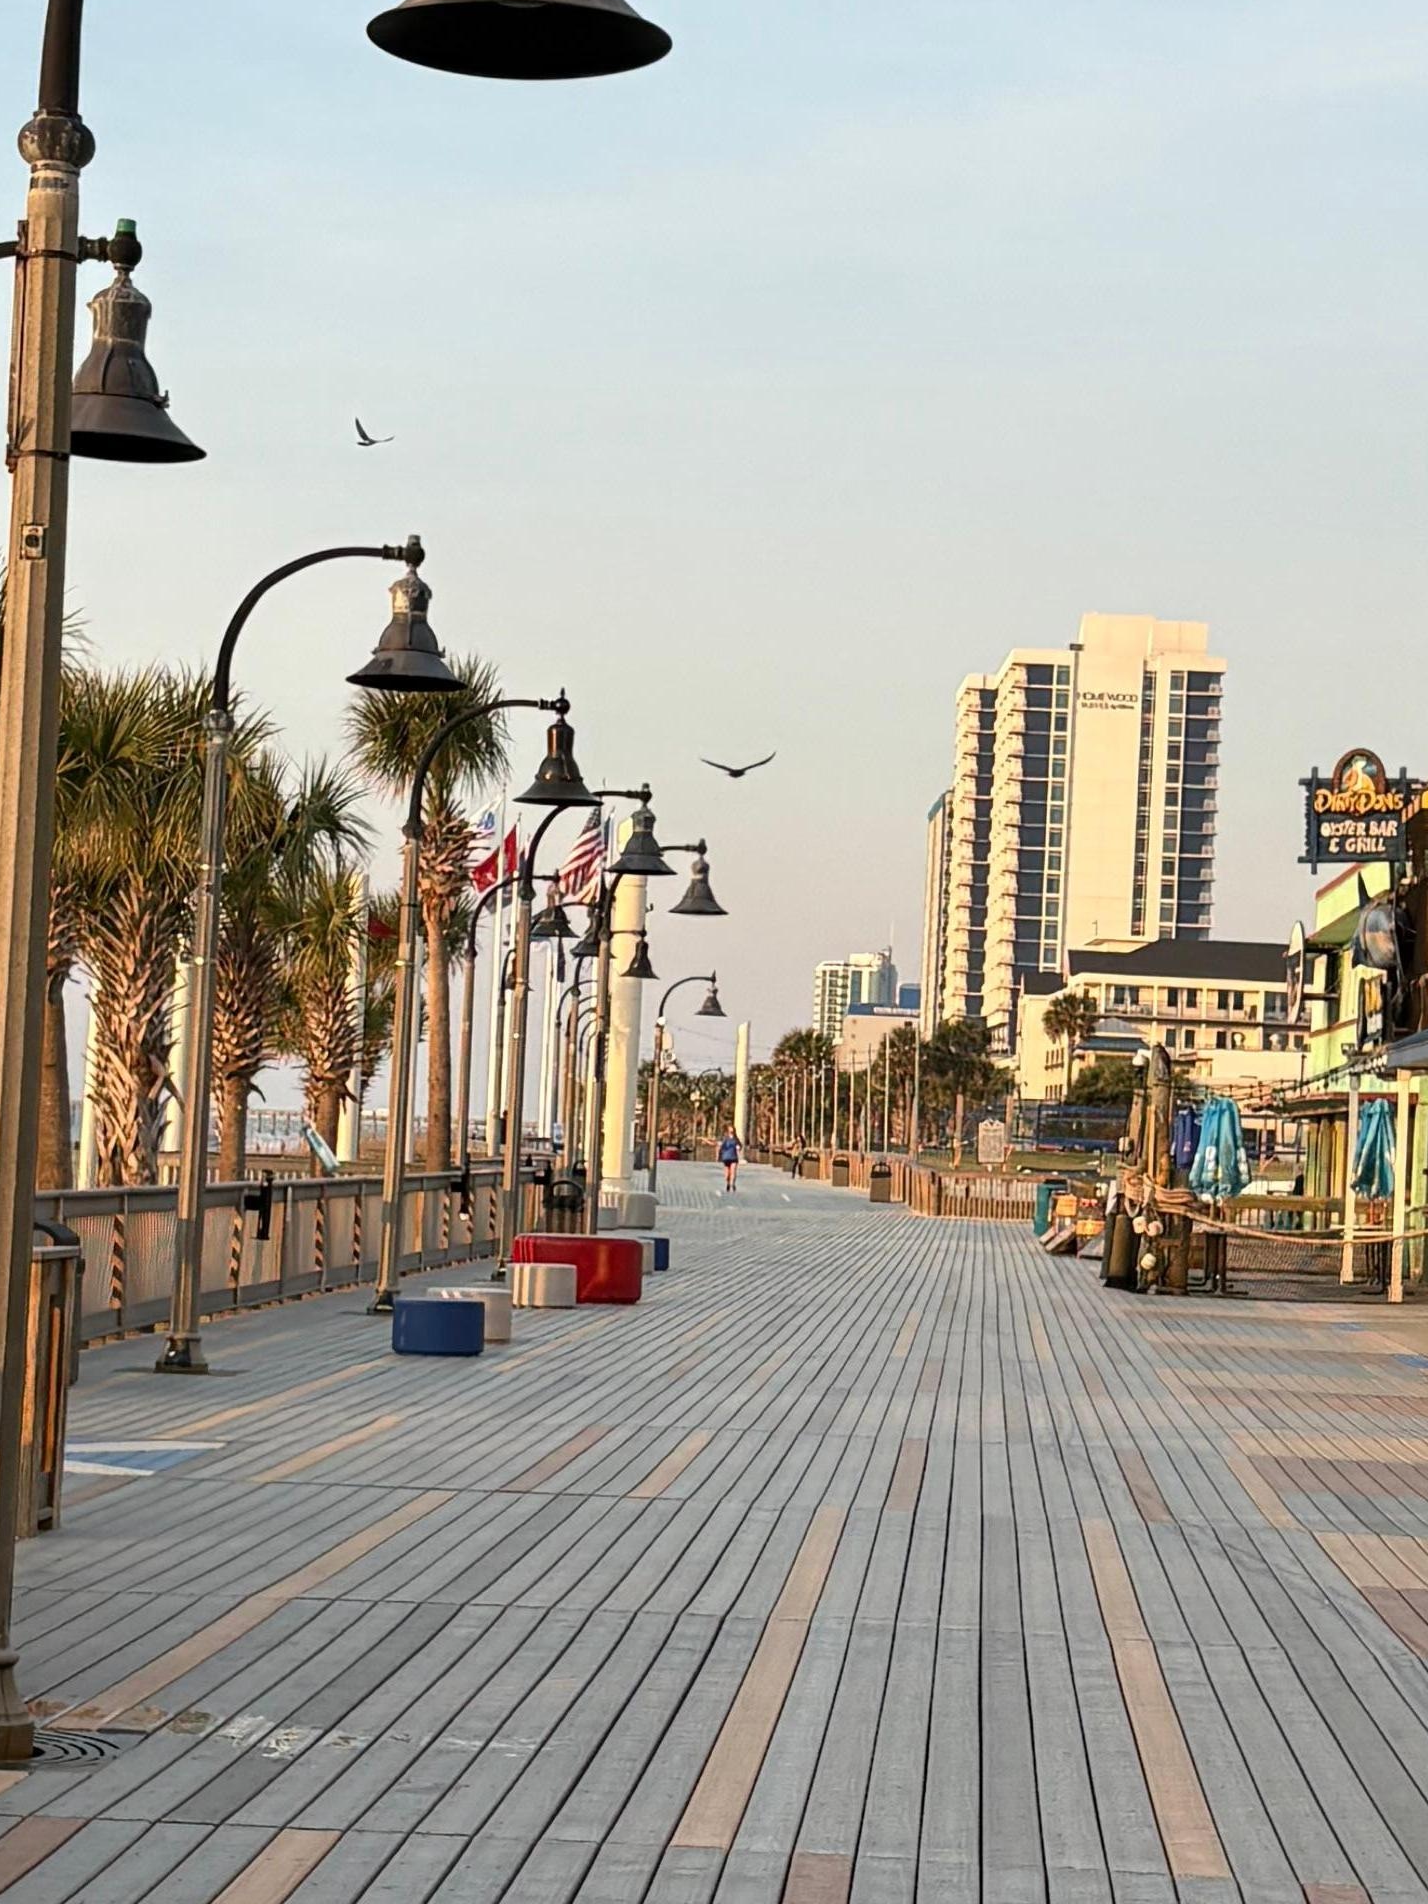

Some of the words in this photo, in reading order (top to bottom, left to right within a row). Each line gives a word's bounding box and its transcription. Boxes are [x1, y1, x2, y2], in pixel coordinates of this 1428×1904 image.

[1314, 788, 1357, 814] DIRTY
[1320, 820, 1366, 837] OYSTER
[1369, 820, 1398, 837] BAR
[1345, 837, 1386, 853] GRILL
